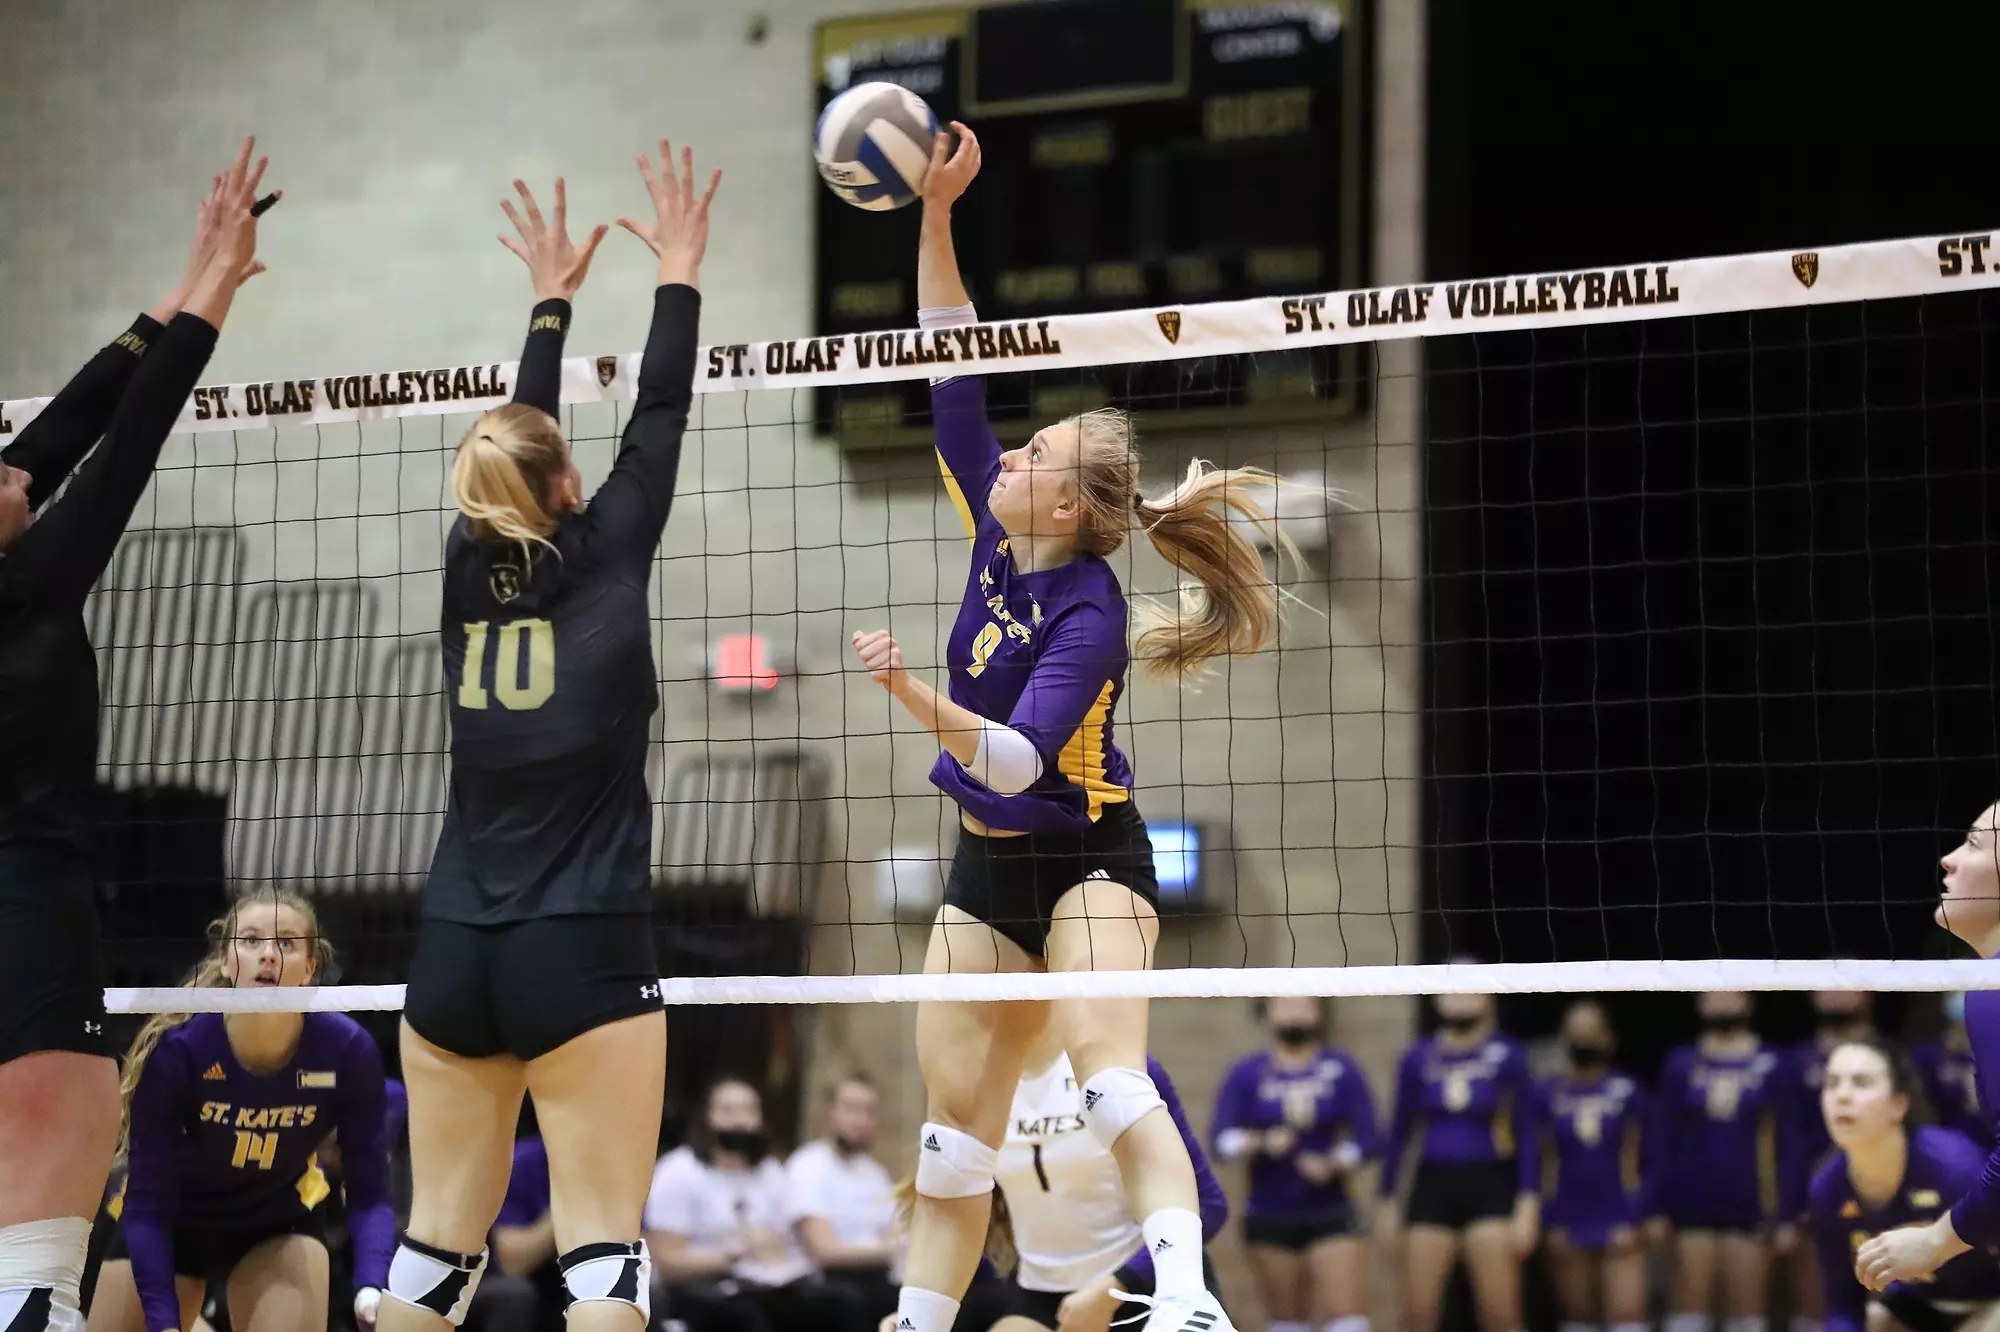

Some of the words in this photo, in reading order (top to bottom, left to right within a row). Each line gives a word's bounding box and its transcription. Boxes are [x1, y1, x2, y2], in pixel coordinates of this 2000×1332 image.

[1281, 297, 1335, 334] ST.
[1346, 287, 1434, 327] OLAF
[1445, 266, 1679, 318] VOLLEYBALL
[707, 345, 756, 379] ST.
[765, 337, 845, 375] OLAF
[854, 320, 1061, 369] VOLLEYBALL
[194, 386, 239, 420] ST.
[245, 378, 316, 416] OLAF
[324, 365, 506, 410] VOLLEYBALL
[458, 617, 556, 711] 10
[965, 621, 1003, 679] 9
[200, 1101, 231, 1125] ST.
[235, 1105, 317, 1129] KATE'S
[231, 1130, 279, 1170] 14
[1031, 1144, 1050, 1193] 1
